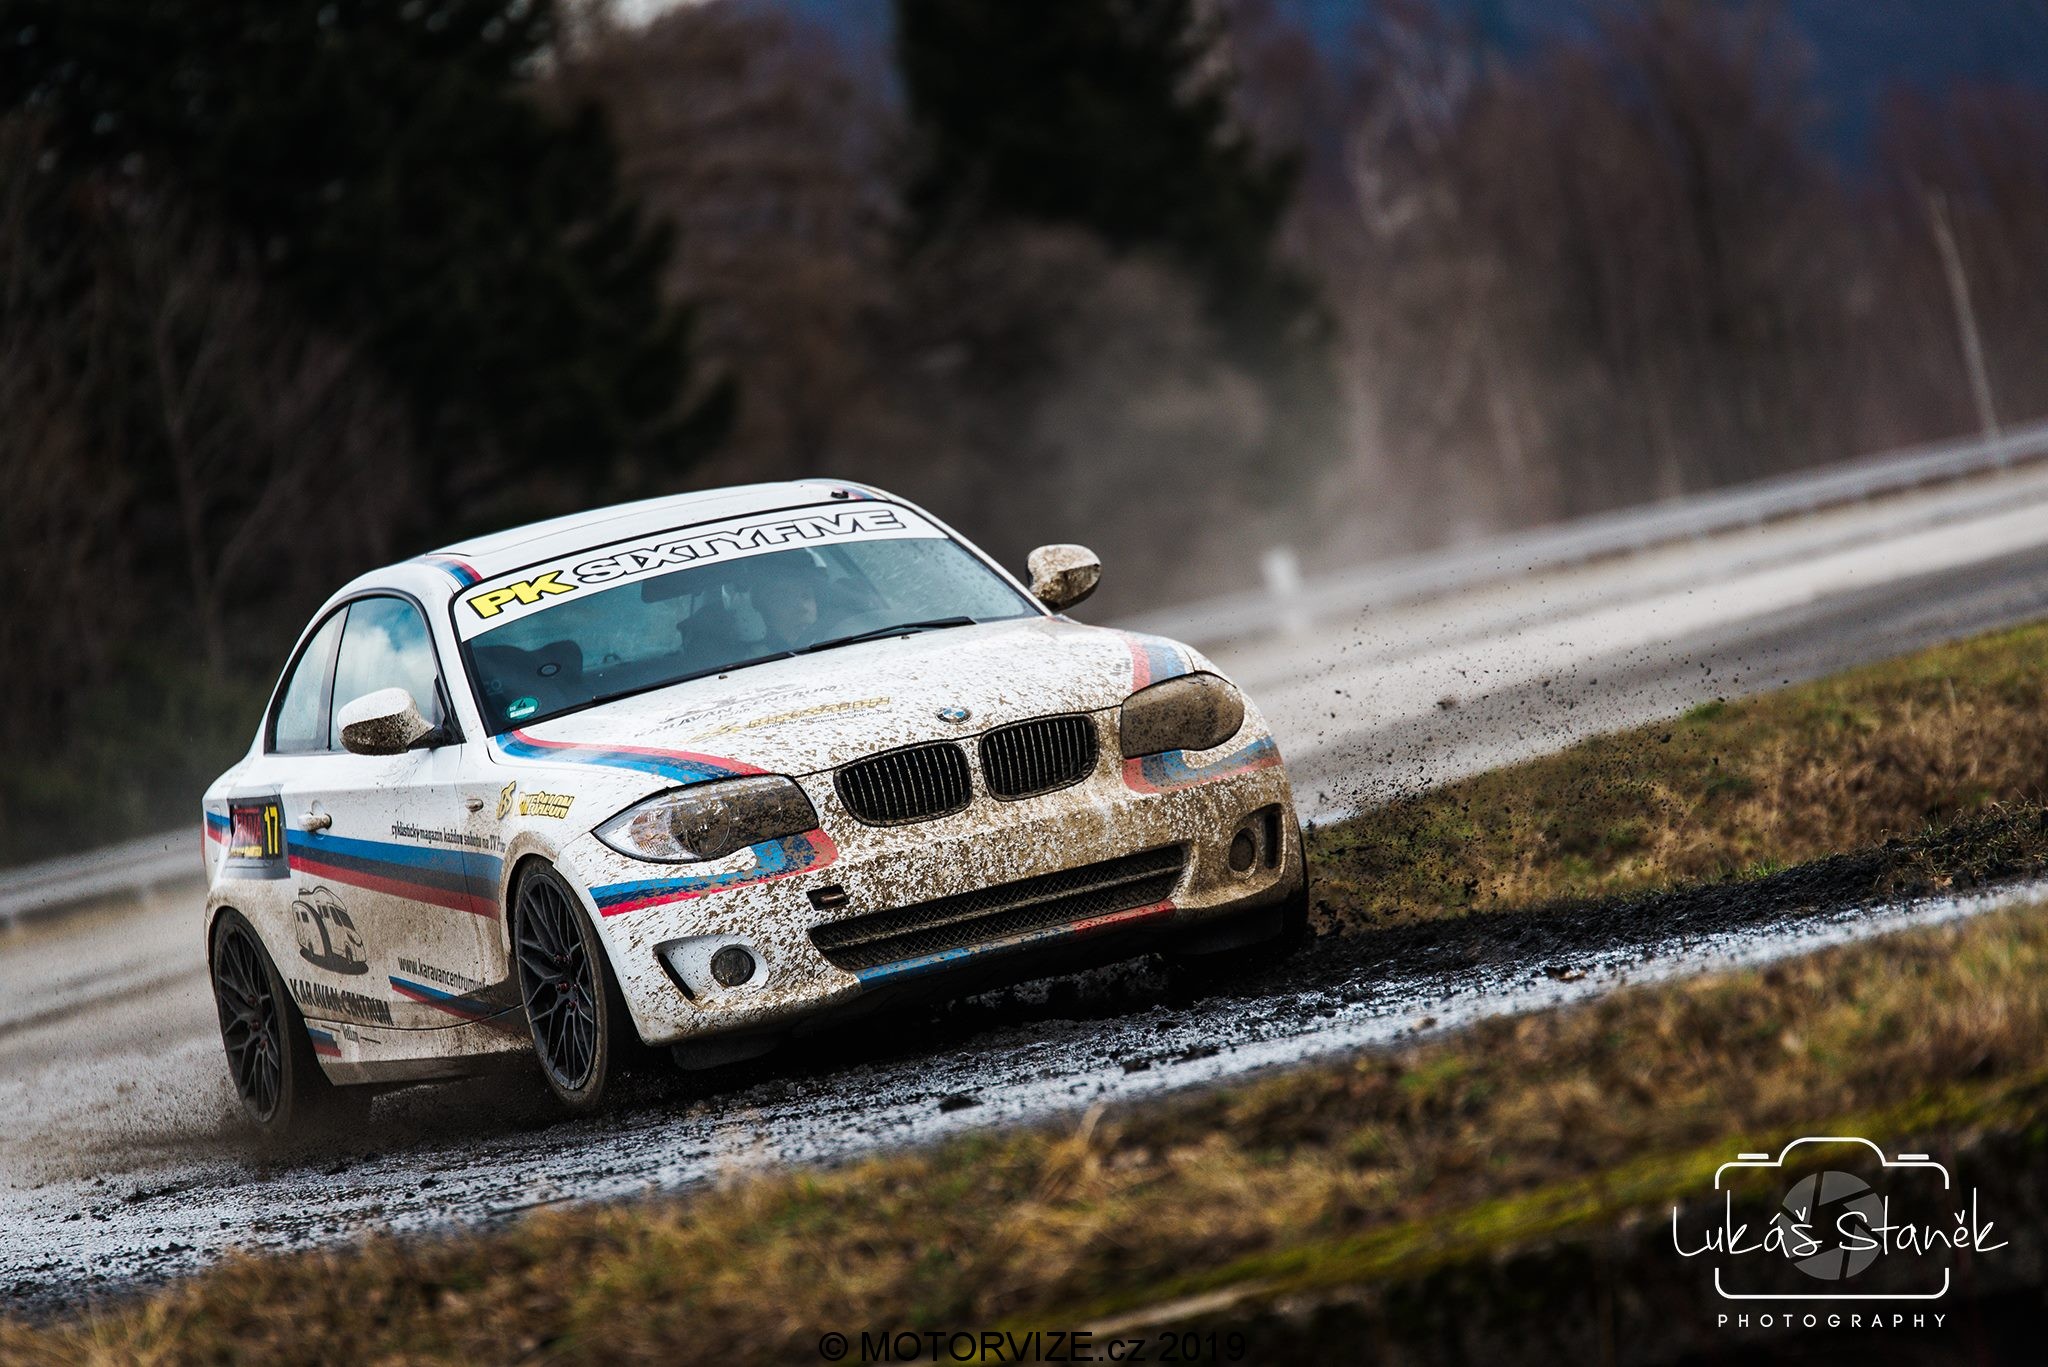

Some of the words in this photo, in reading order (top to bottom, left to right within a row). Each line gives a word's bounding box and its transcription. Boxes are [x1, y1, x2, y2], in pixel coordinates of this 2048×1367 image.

[466, 569, 580, 620] PK
[572, 508, 908, 584] SIXTYFIVE
[264, 805, 279, 855] 17
